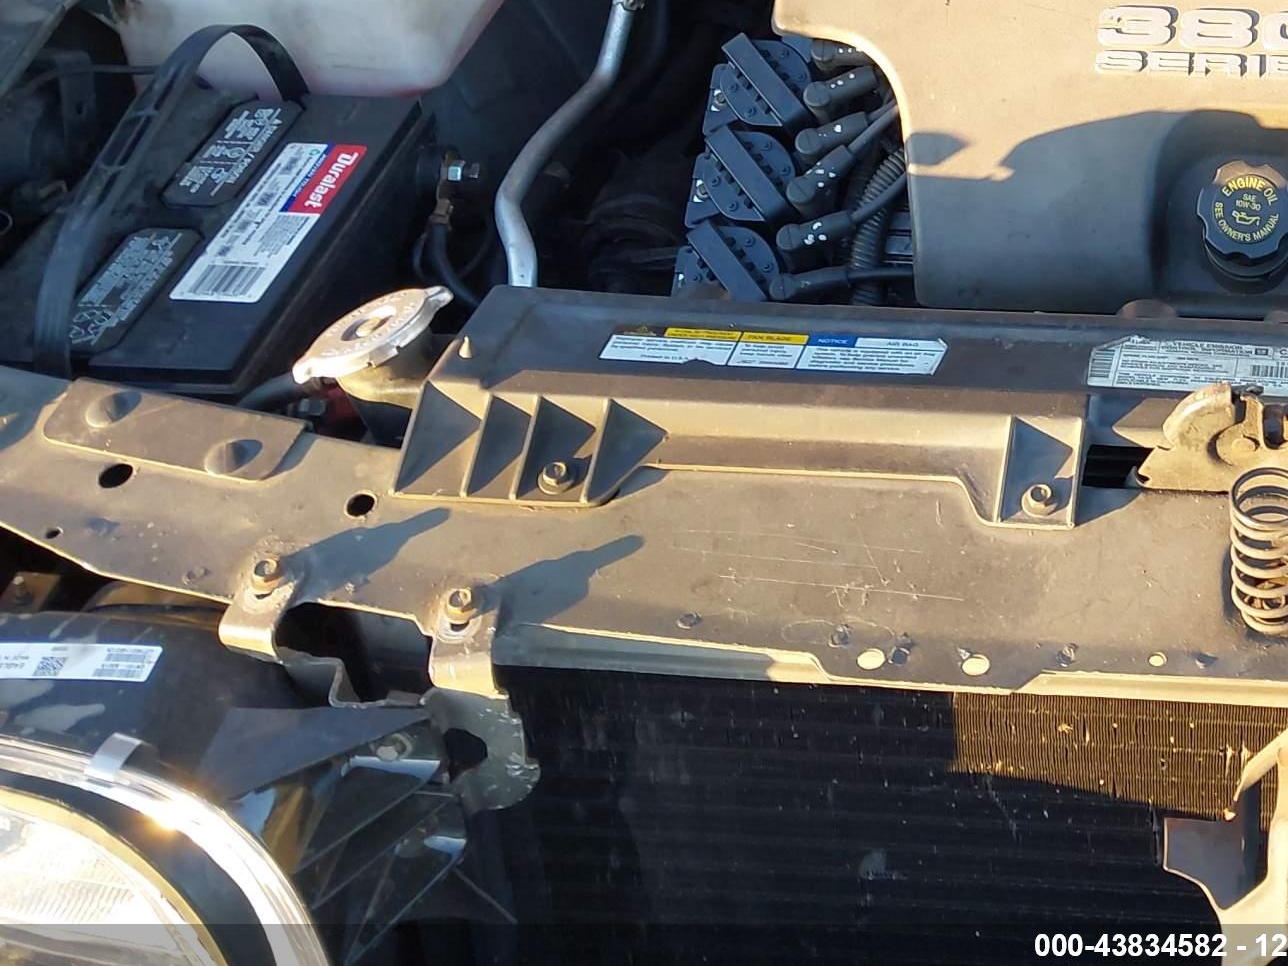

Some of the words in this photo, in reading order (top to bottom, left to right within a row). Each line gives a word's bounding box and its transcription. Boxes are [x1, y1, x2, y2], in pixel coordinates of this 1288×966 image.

[304, 152, 360, 208] Duralast
[1222, 177, 1265, 197] ENGINE
[1263, 187, 1278, 206] OIL
[1243, 193, 1257, 202] SAE
[1214, 201, 1224, 218] SEE
[1252, 213, 1280, 242] MANUAL
